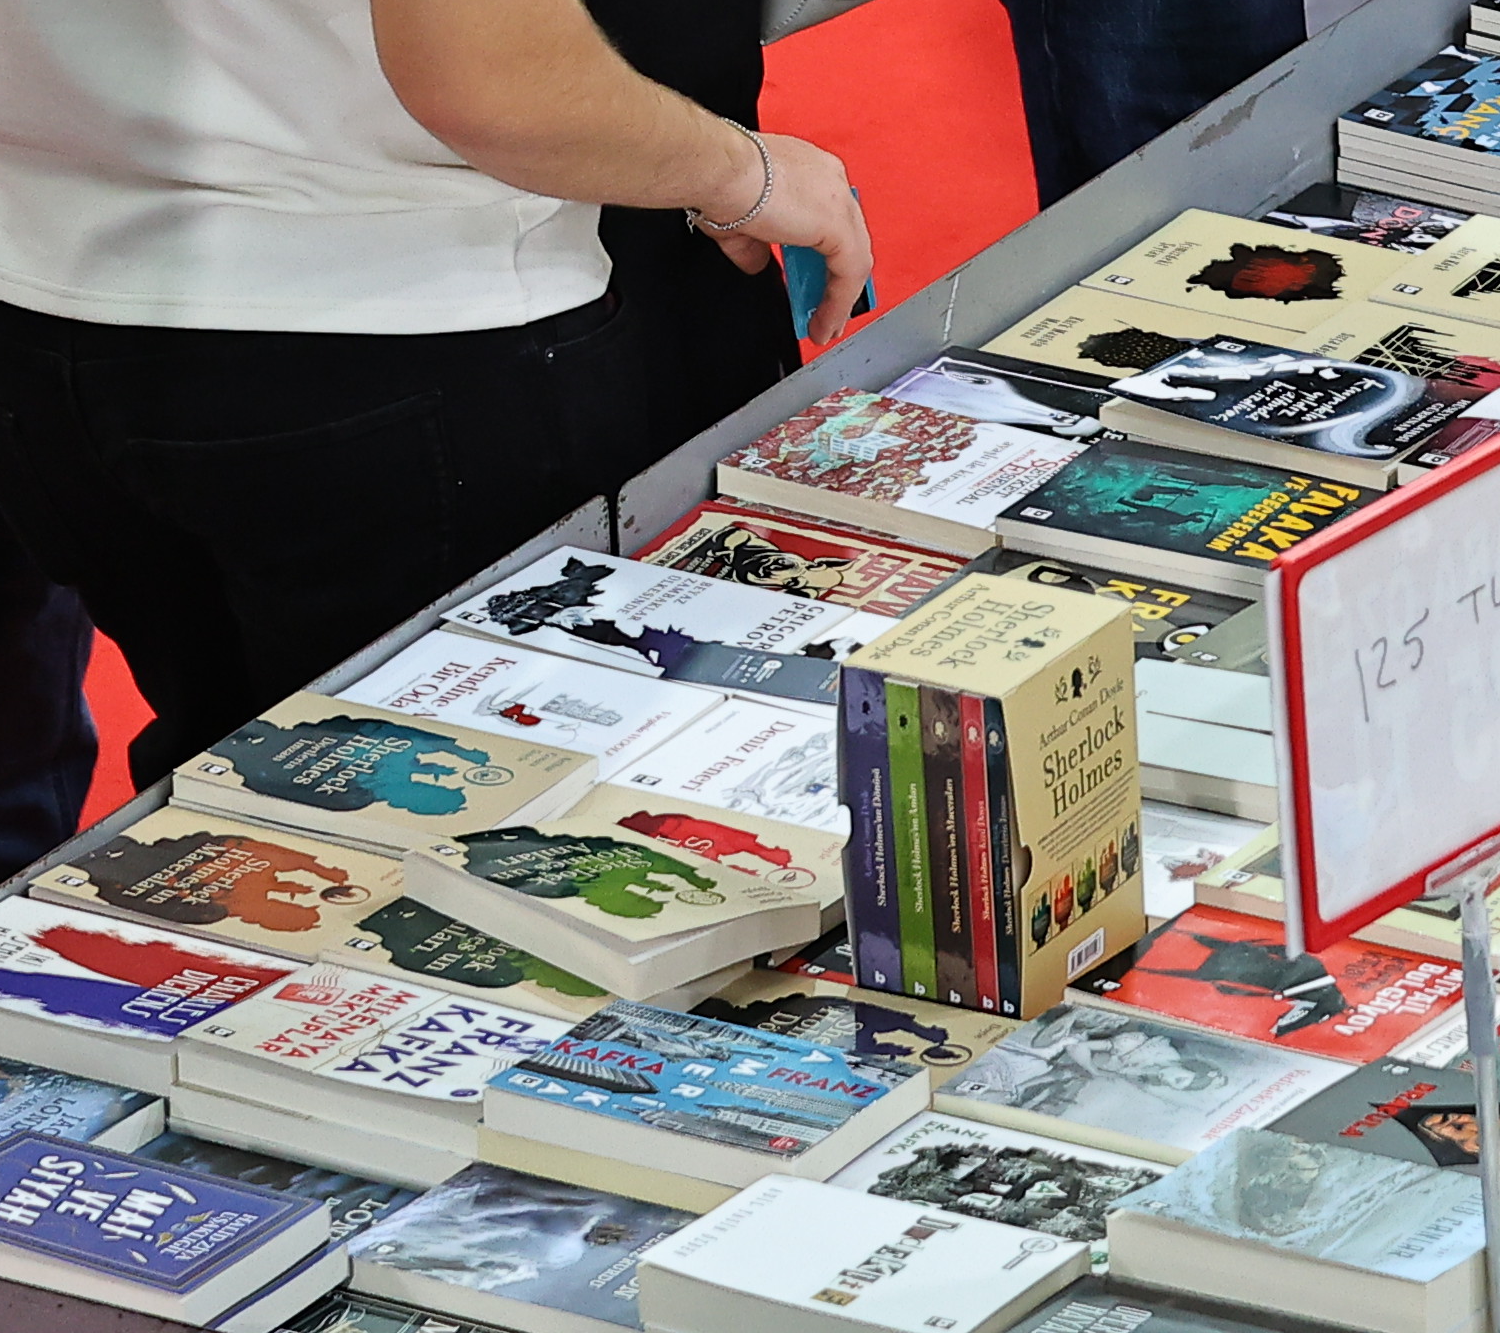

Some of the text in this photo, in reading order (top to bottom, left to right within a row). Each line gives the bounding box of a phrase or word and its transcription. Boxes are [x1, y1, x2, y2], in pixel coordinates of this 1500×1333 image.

[915, 439, 1016, 499] ayaşlı ile kiracıları
[950, 462, 1030, 507] ESENDAL
[1222, 482, 1368, 561] FALAKA
[614, 574, 681, 614] ÜLKESİNDE
[624, 577, 698, 622] ZAMBAKLAR
[670, 581, 714, 605] BEYAZ
[865, 583, 992, 662] Arthur Conan Doyle
[906, 598, 1015, 660] Holmes
[935, 600, 1056, 671] Sherlock
[386, 660, 473, 710] Bir Oda
[427, 656, 517, 708] Kendine
[1354, 608, 1430, 723] 125
[288, 734, 379, 787] Holmes
[310, 735, 413, 796] Sherlock
[677, 719, 797, 793] Deniz Feneri
[1043, 705, 1126, 788] Sherlock
[1052, 748, 1123, 819] Holmes
[118, 842, 223, 898] Maceraları
[144, 848, 252, 905] Holmes'un
[179, 857, 273, 906] Sherlock
[527, 856, 649, 888] Sherlock
[117, 968, 216, 1017] DICKENS
[154, 975, 260, 1024] CHARLES
[254, 984, 390, 1052] MEKTUPLAR
[1325, 961, 1449, 1035] BULGAKOV
[334, 1004, 486, 1077] KAFKA
[382, 1016, 533, 1087] FRANZ
[544, 1036, 673, 1078] KAFKA
[765, 1065, 876, 1100] FRANZ
[1246, 1067, 1312, 1105] Vadideki
[1337, 1071, 1452, 1139] DRACULA
[881, 1126, 935, 1157] KAFKA
[923, 1120, 988, 1140] FRANZ
[1195, 1103, 1260, 1141] Zambak
[50, 1188, 119, 1220] VE
[96, 1189, 168, 1240] MAİ
[157, 1209, 238, 1257] UŞAKLIGİL
